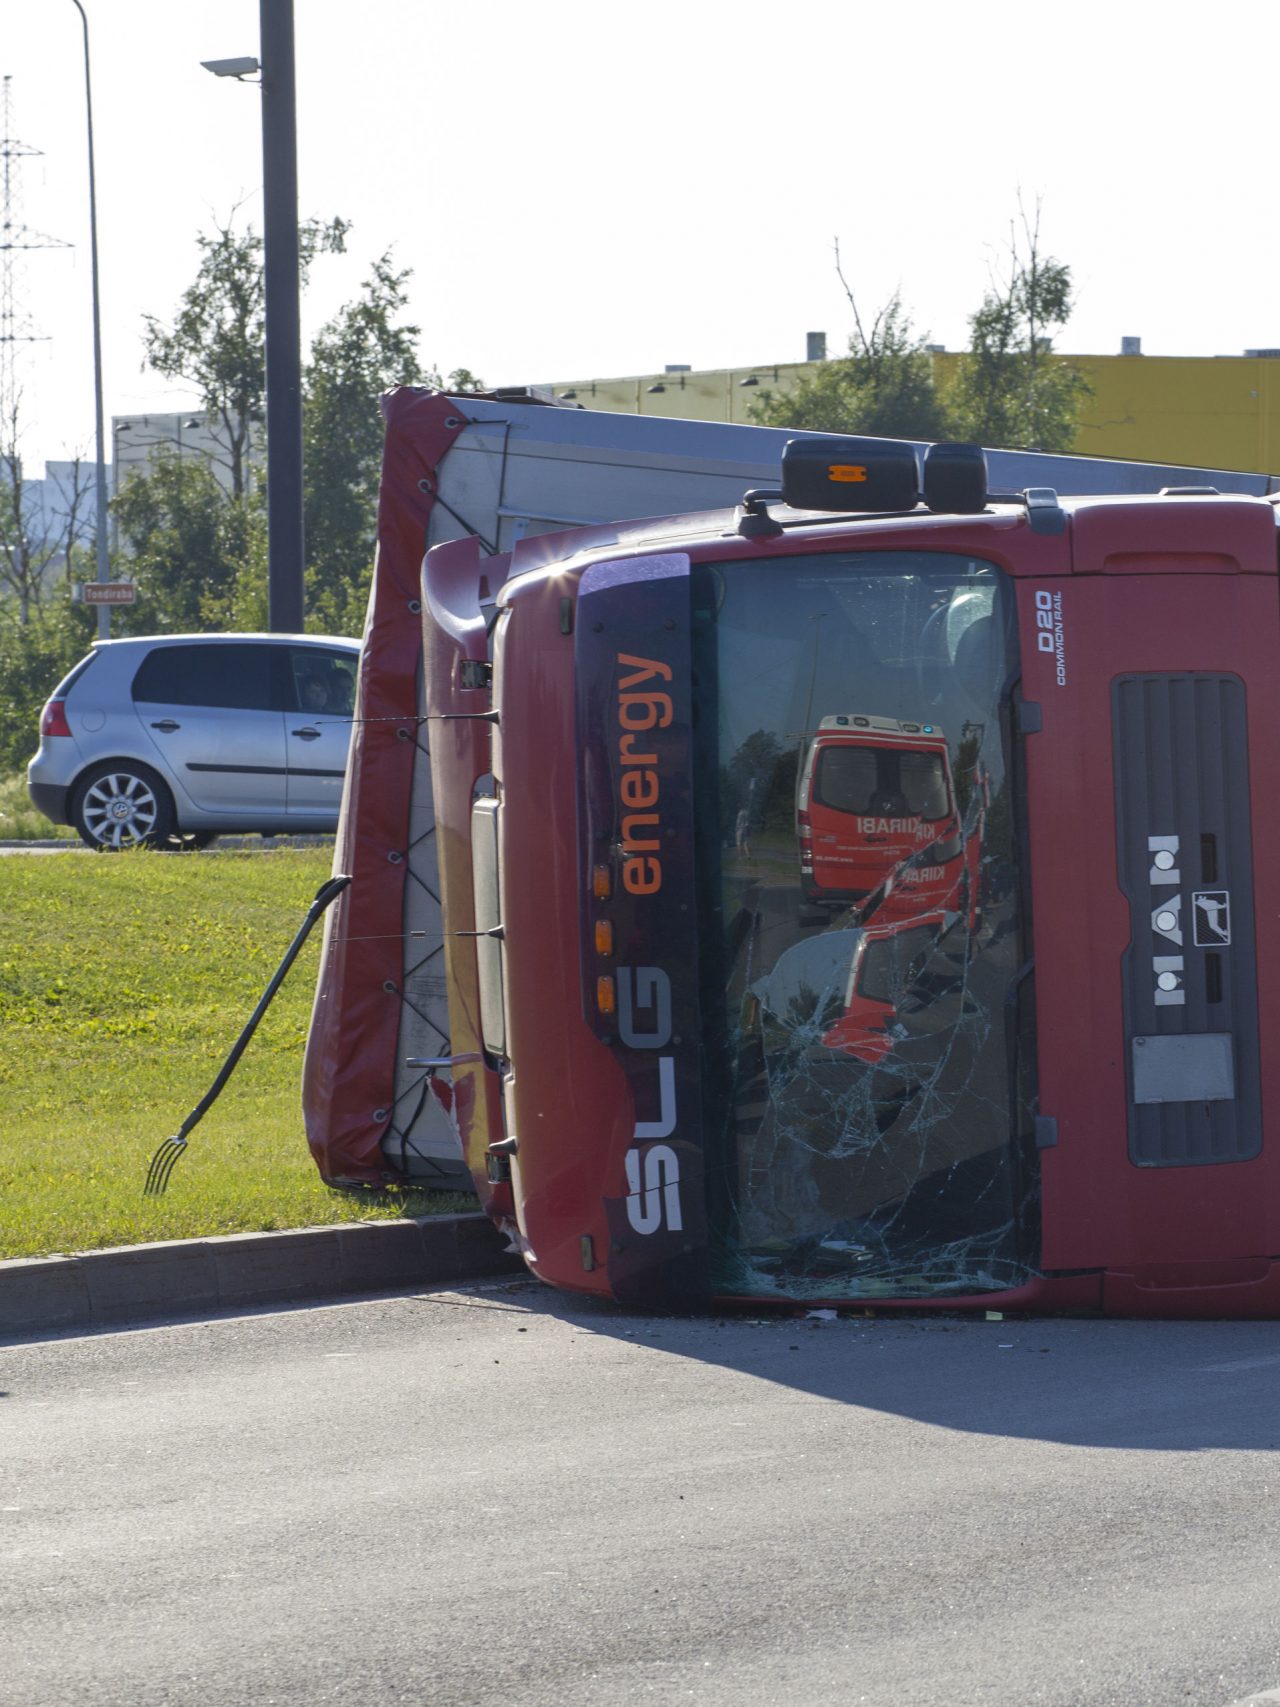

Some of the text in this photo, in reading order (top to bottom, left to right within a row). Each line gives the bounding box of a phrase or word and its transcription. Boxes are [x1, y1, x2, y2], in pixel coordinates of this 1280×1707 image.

[1052, 591, 1066, 686] COMMON RAIL
[617, 652, 684, 1236] SLG energy
